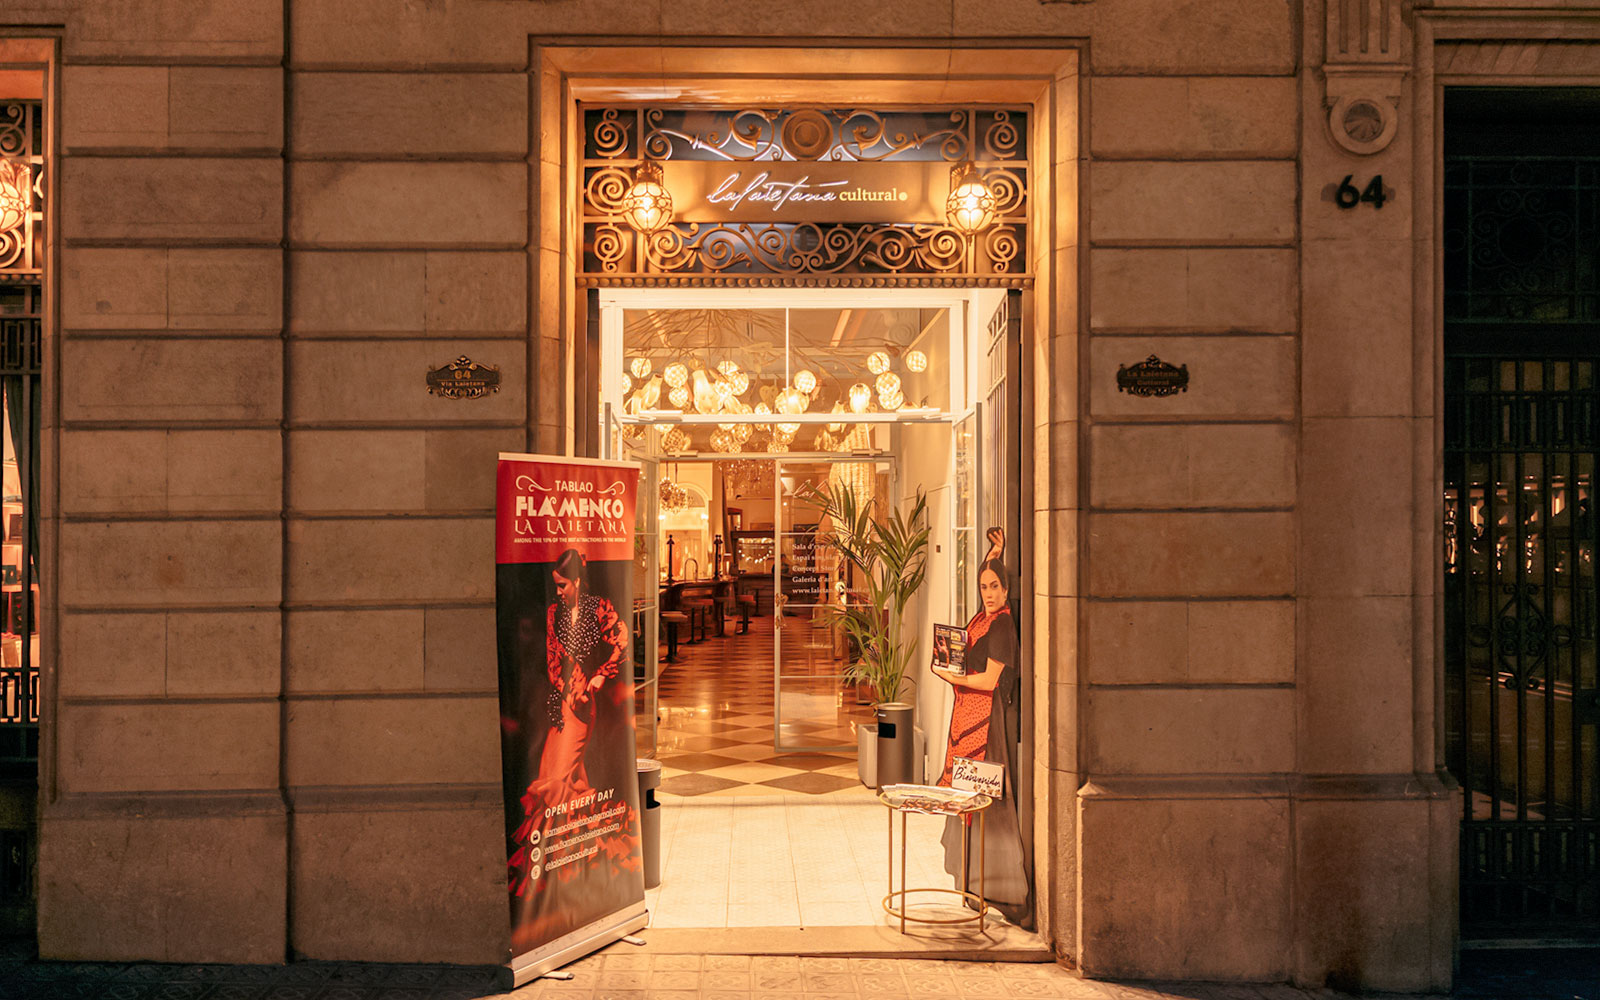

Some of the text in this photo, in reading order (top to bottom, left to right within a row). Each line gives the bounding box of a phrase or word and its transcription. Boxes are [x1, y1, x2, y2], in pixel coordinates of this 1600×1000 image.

[1335, 174, 1386, 209] 64
[454, 370, 471, 379] 64
[555, 480, 594, 493] TABLAO
[515, 495, 625, 519] FLAMENCO
[514, 519, 628, 535] LA LAIETANA
[792, 565, 818, 573] Concept
[545, 789, 614, 818] OPEN EVERY DAY
